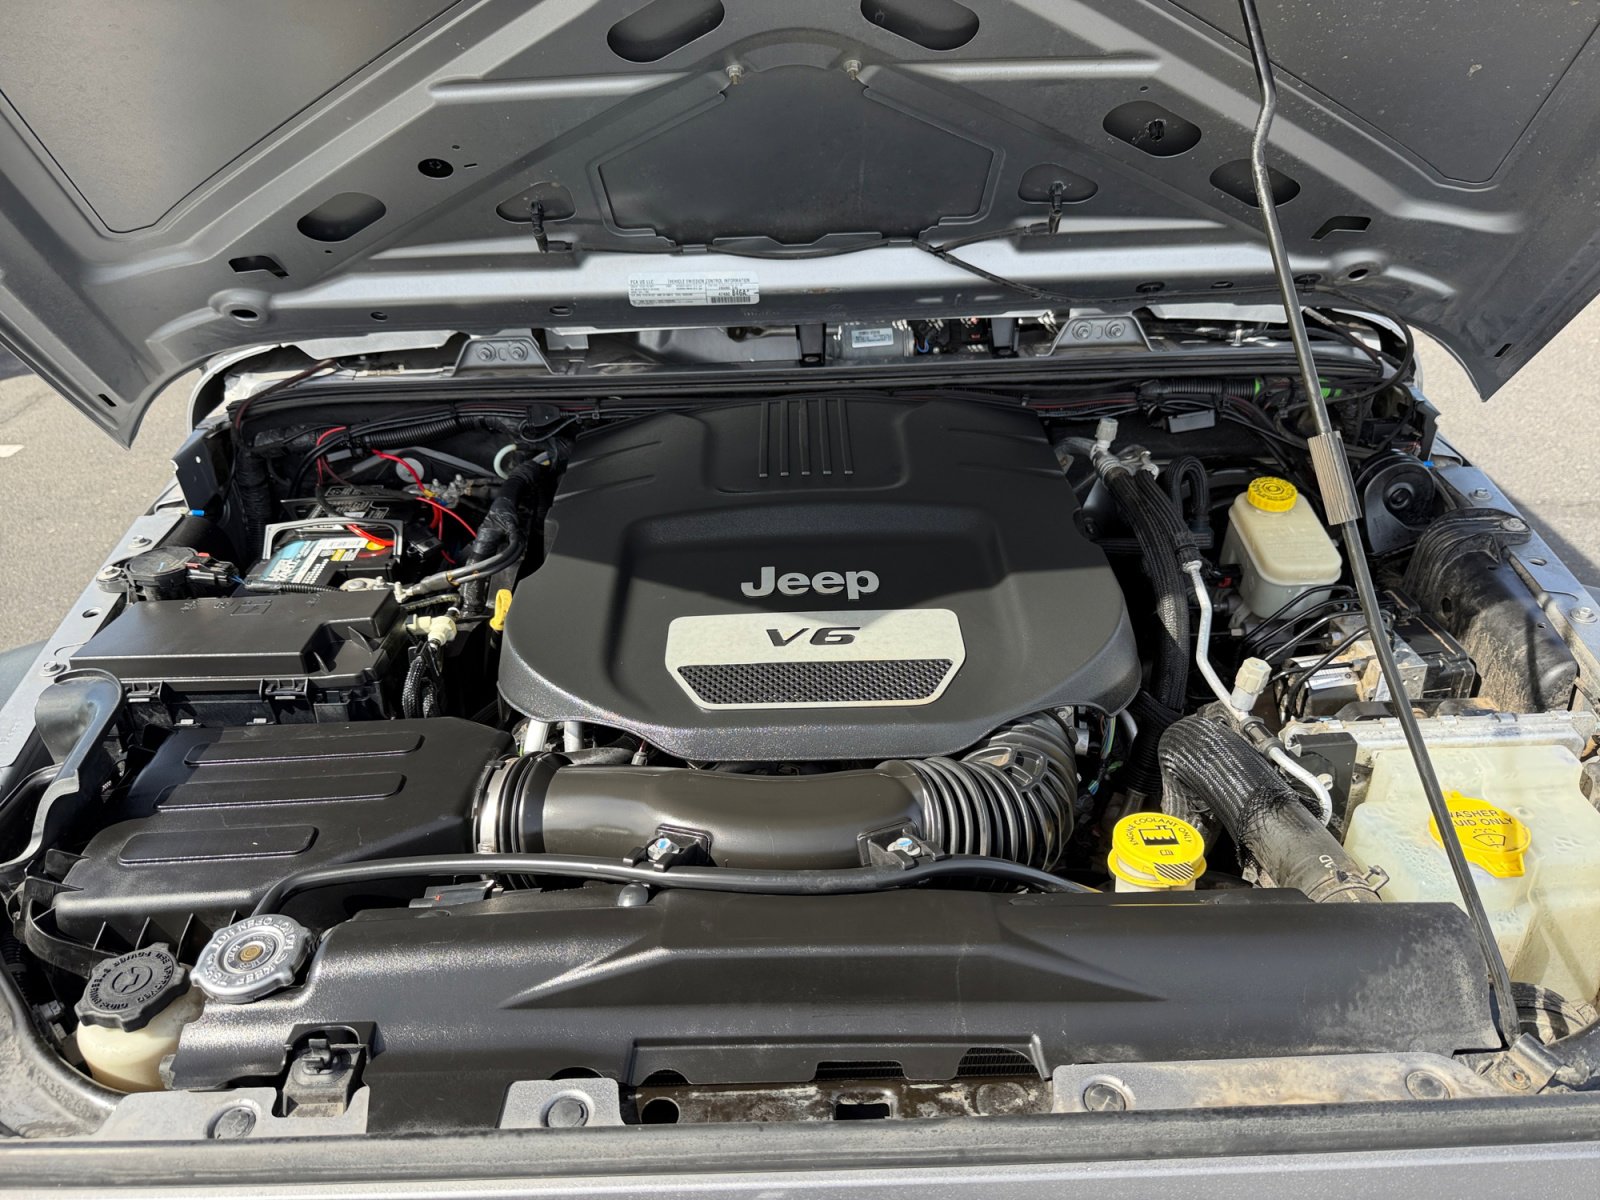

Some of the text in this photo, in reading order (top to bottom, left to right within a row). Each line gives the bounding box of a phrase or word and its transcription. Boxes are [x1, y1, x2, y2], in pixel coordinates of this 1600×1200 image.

[740, 566, 880, 601] Jeep
[766, 627, 861, 646] V6
[1480, 817, 1513, 826] ONLY
[1126, 816, 1192, 847] ENGINE COOLANT ONLY
[238, 917, 274, 932] OPEN
